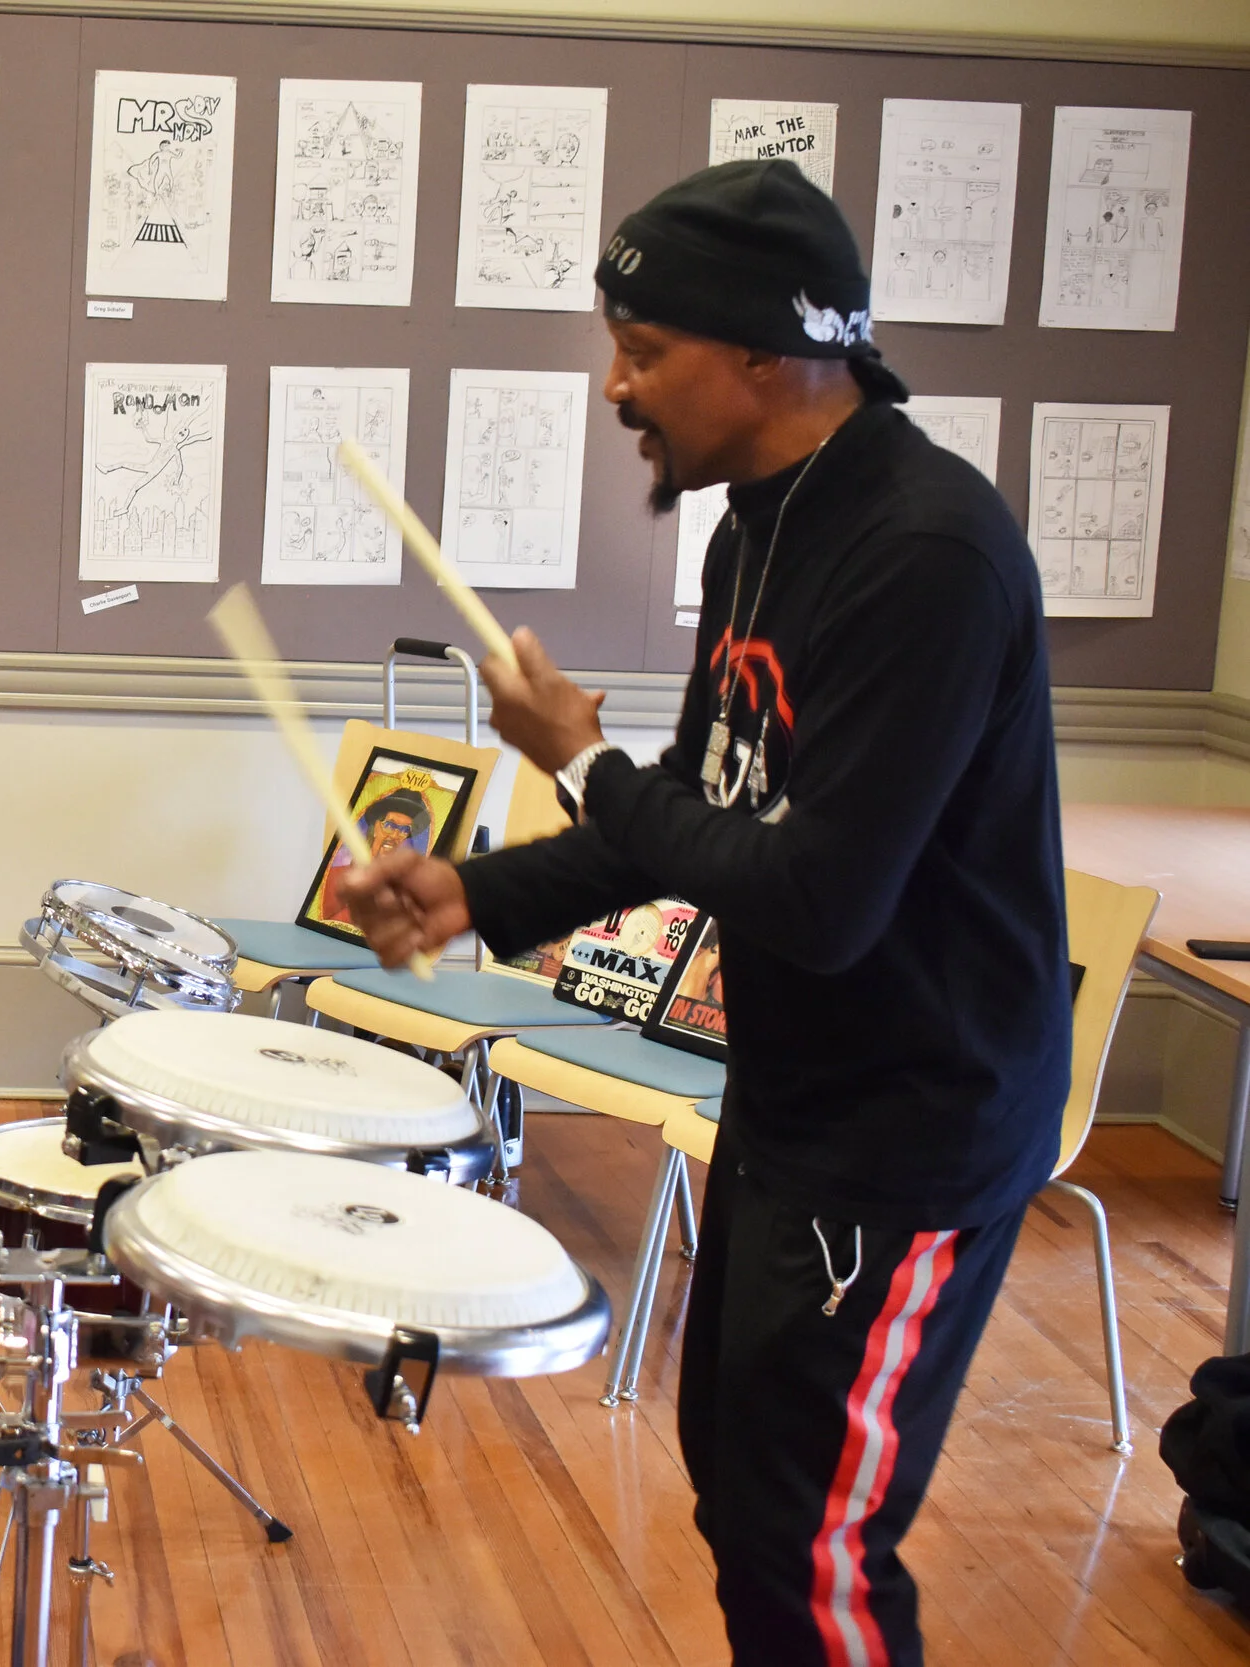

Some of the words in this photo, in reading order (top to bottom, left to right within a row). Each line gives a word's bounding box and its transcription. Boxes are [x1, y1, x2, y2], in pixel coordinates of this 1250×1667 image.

[117, 97, 176, 134] MR
[734, 125, 766, 144] MARC
[776, 116, 805, 134] THE
[757, 134, 815, 160] MENTOR
[402, 769, 429, 788] Style
[663, 933, 680, 952] TO
[589, 948, 662, 985] MAX
[574, 982, 605, 1006] GO
[623, 998, 654, 1022] GO
[580, 972, 658, 1004] WASHINGTON
[668, 998, 692, 1021] IN
